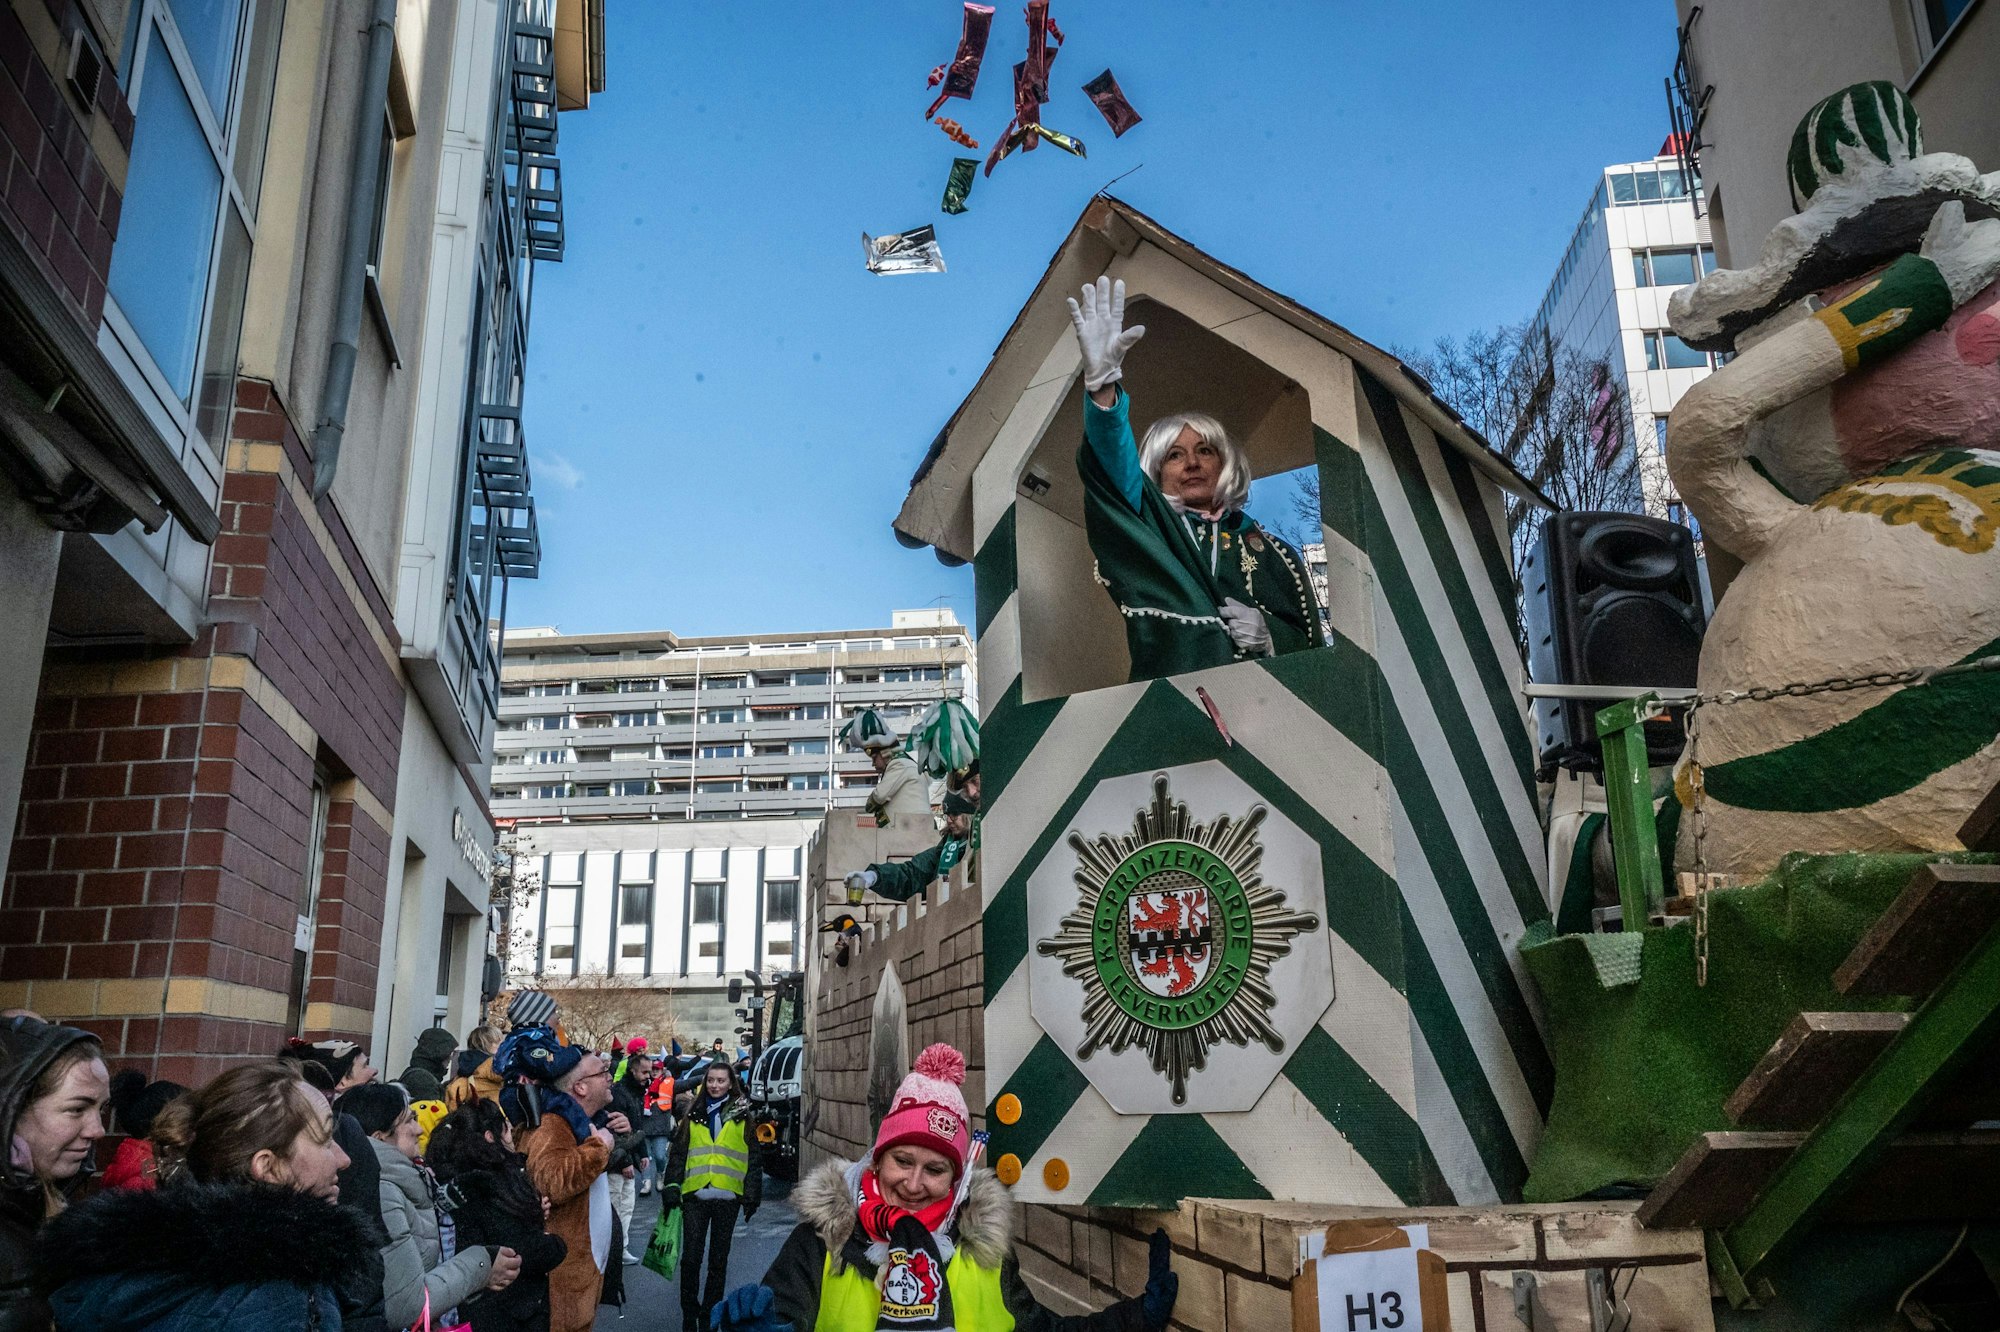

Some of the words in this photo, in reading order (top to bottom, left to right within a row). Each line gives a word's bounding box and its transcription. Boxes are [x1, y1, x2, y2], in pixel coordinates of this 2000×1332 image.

[1108, 850, 1248, 949] PRINZENGARDE
[1109, 964, 1241, 1023] LEVERKUSEN
[881, 1304, 931, 1317] everkusen
[1345, 1291, 1405, 1332] H3
